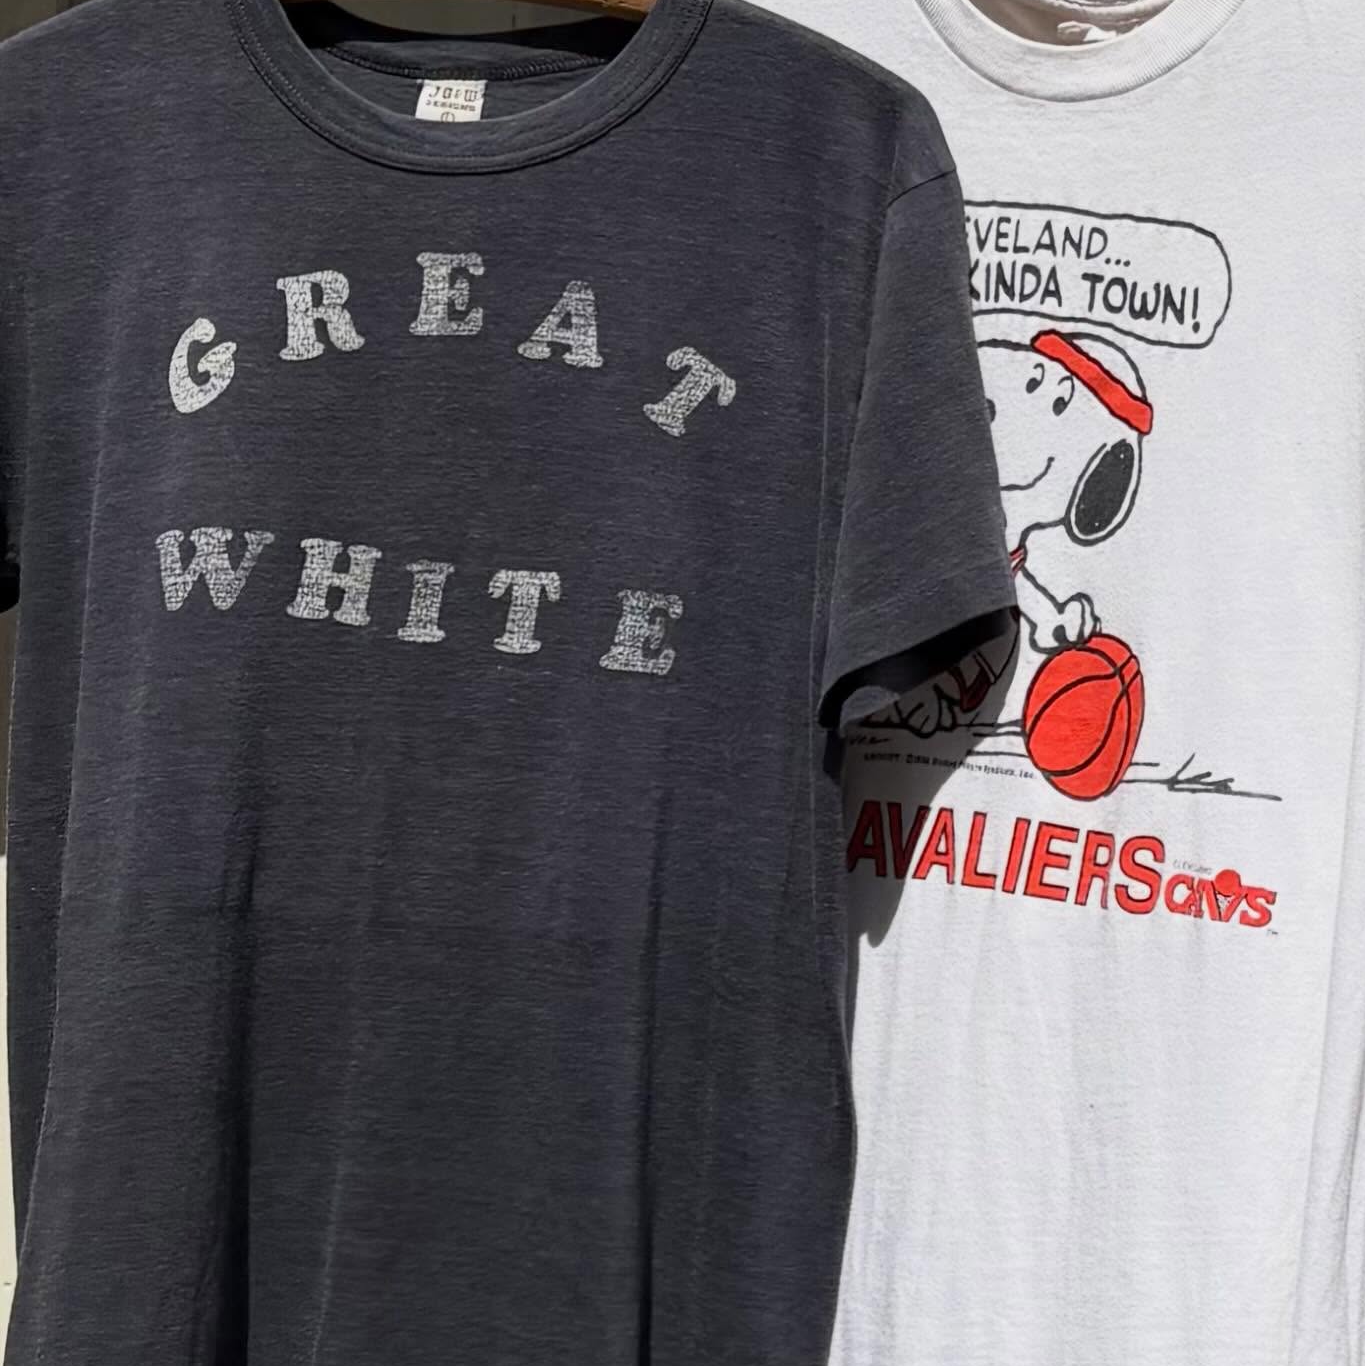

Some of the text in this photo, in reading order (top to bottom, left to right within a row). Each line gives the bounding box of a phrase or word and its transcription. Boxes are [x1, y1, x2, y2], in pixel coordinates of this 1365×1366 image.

[965, 216, 1131, 267] VELAND...
[167, 251, 737, 437] GREAT
[1081, 272, 1200, 333] TOWN!
[155, 526, 684, 676] WHITE
[847, 799, 1166, 915] AVALIERS
